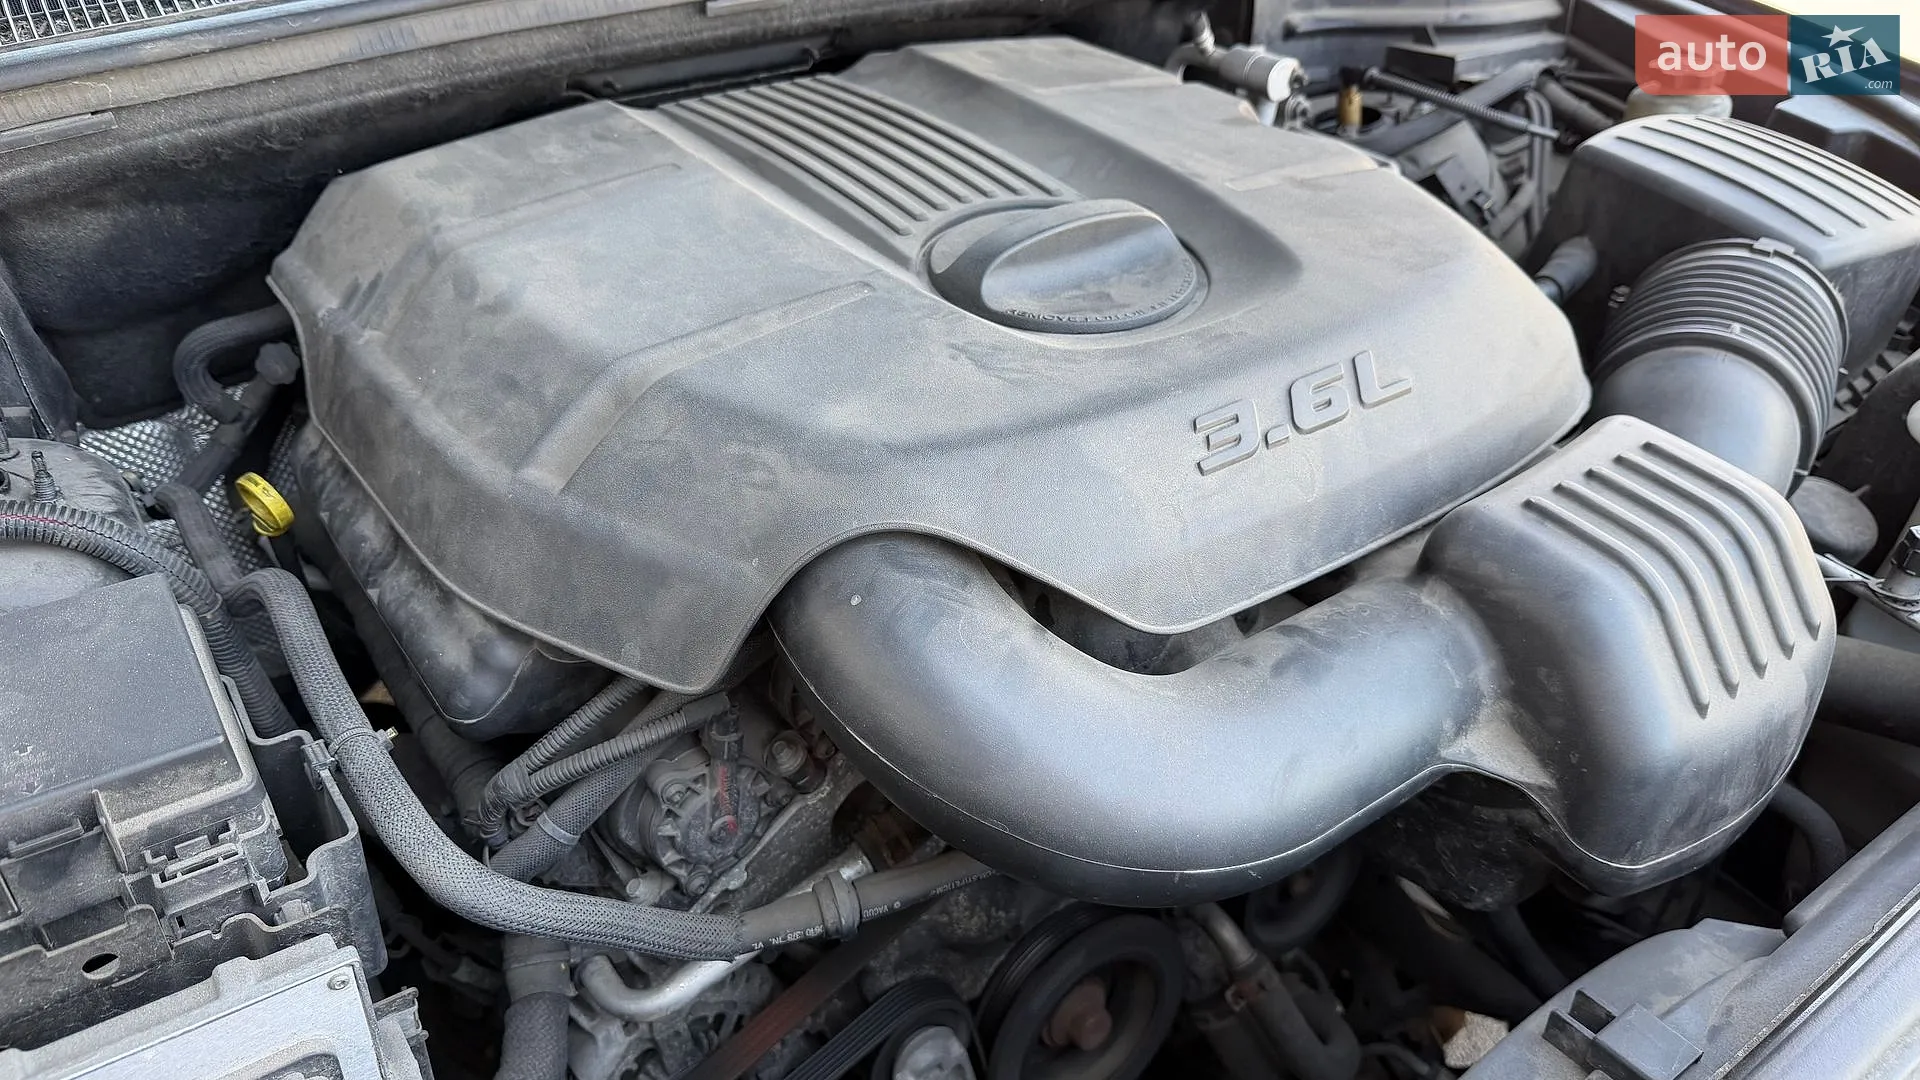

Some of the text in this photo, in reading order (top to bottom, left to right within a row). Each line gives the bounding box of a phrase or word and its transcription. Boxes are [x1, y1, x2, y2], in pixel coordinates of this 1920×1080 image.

[1005, 308, 1078, 323] REMOVE
[1192, 350, 1413, 476] 3.6L
[863, 904, 889, 919] VACUU
